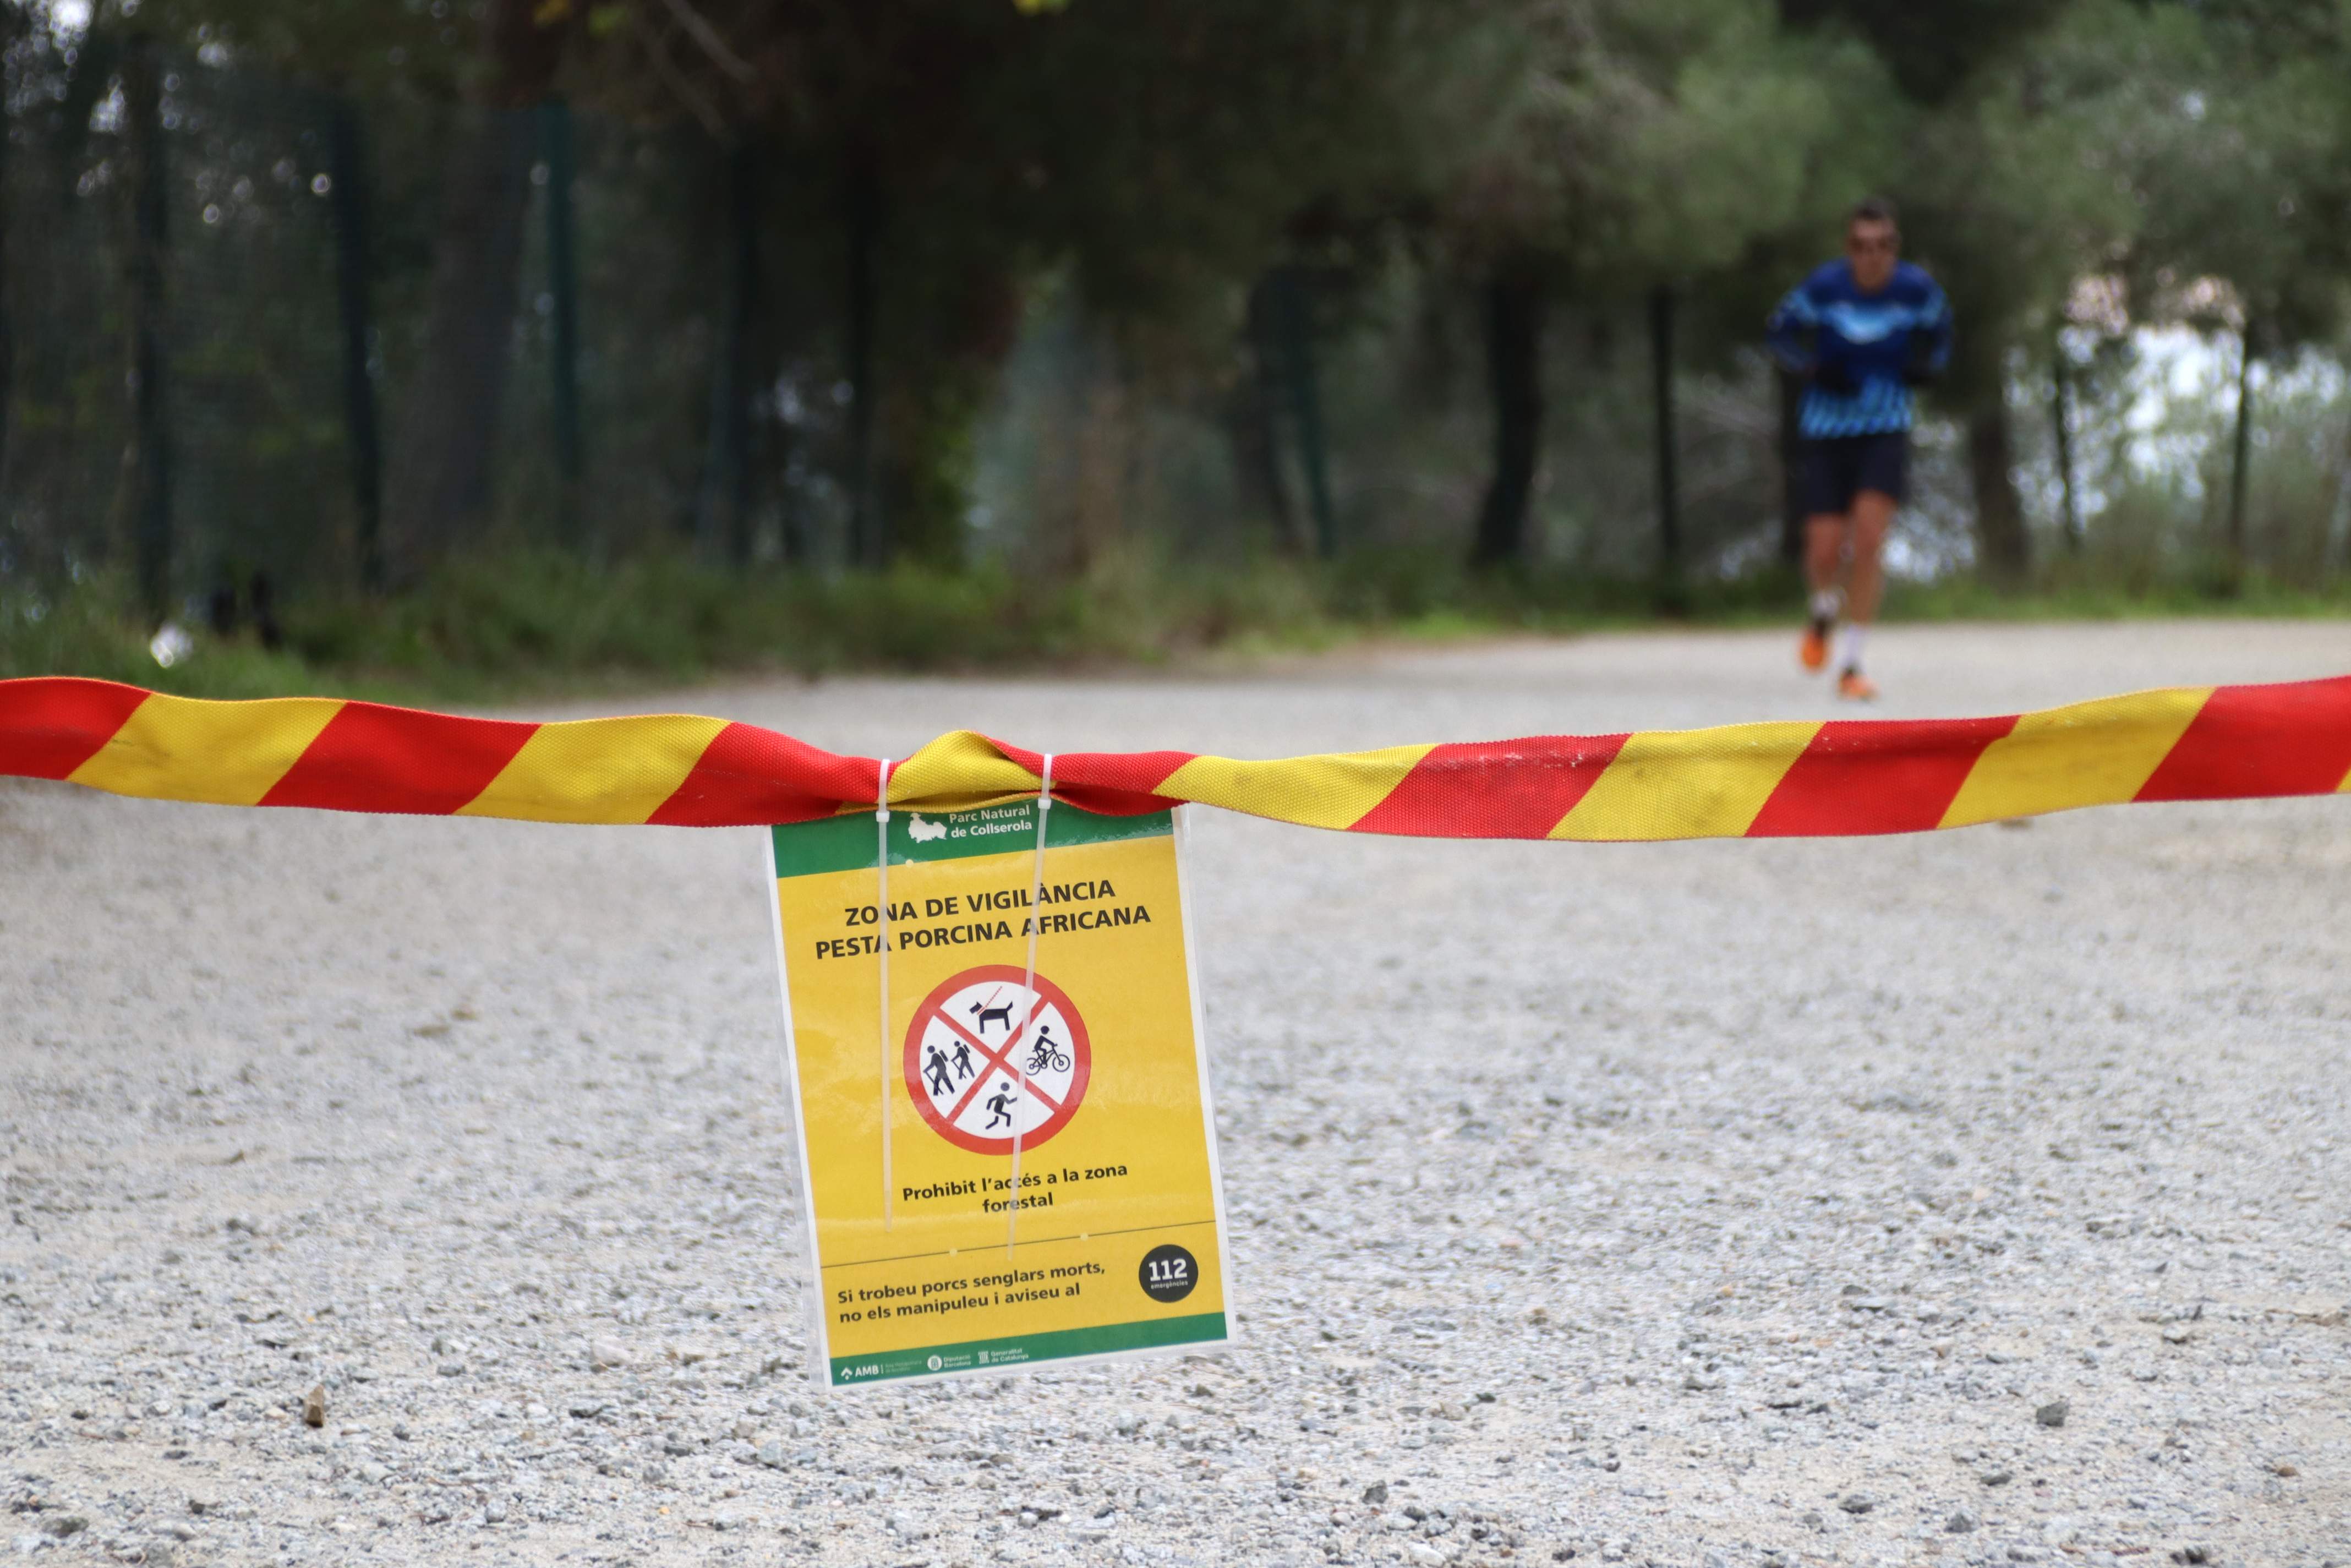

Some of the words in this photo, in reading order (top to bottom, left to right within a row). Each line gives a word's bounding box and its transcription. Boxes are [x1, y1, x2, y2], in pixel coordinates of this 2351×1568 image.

[949, 813, 977, 823] Parc
[981, 805, 1030, 820] Natural
[951, 827, 966, 838] de
[970, 820, 1032, 835] Collserola
[845, 902, 918, 926] ZONA
[926, 897, 959, 917] DE
[966, 880, 1116, 912] VIGILÀNCIA
[816, 935, 892, 959] PESTA
[899, 921, 1013, 950] PORCINA
[1021, 906, 1151, 936] AFRICANA
[903, 1180, 977, 1201] Prohibit
[1047, 1173, 1057, 1184] a
[1063, 1168, 1079, 1182] la
[1085, 1165, 1127, 1180] zona
[982, 1192, 1053, 1213] forestal
[1149, 1258, 1188, 1281] 112
[838, 1289, 853, 1304] Si
[859, 1286, 916, 1301] trobeu
[922, 1279, 967, 1296] porcs
[973, 1270, 1045, 1288] senglars
[1050, 1262, 1105, 1279] morts,
[839, 1310, 861, 1323] no
[867, 1305, 891, 1320] els
[896, 1294, 988, 1316] manipuleu
[994, 1292, 999, 1305] i
[1005, 1288, 1059, 1303] aviseu
[1065, 1282, 1080, 1296] al
[991, 1348, 1023, 1357] Generalitat
[855, 1364, 879, 1377] AMB
